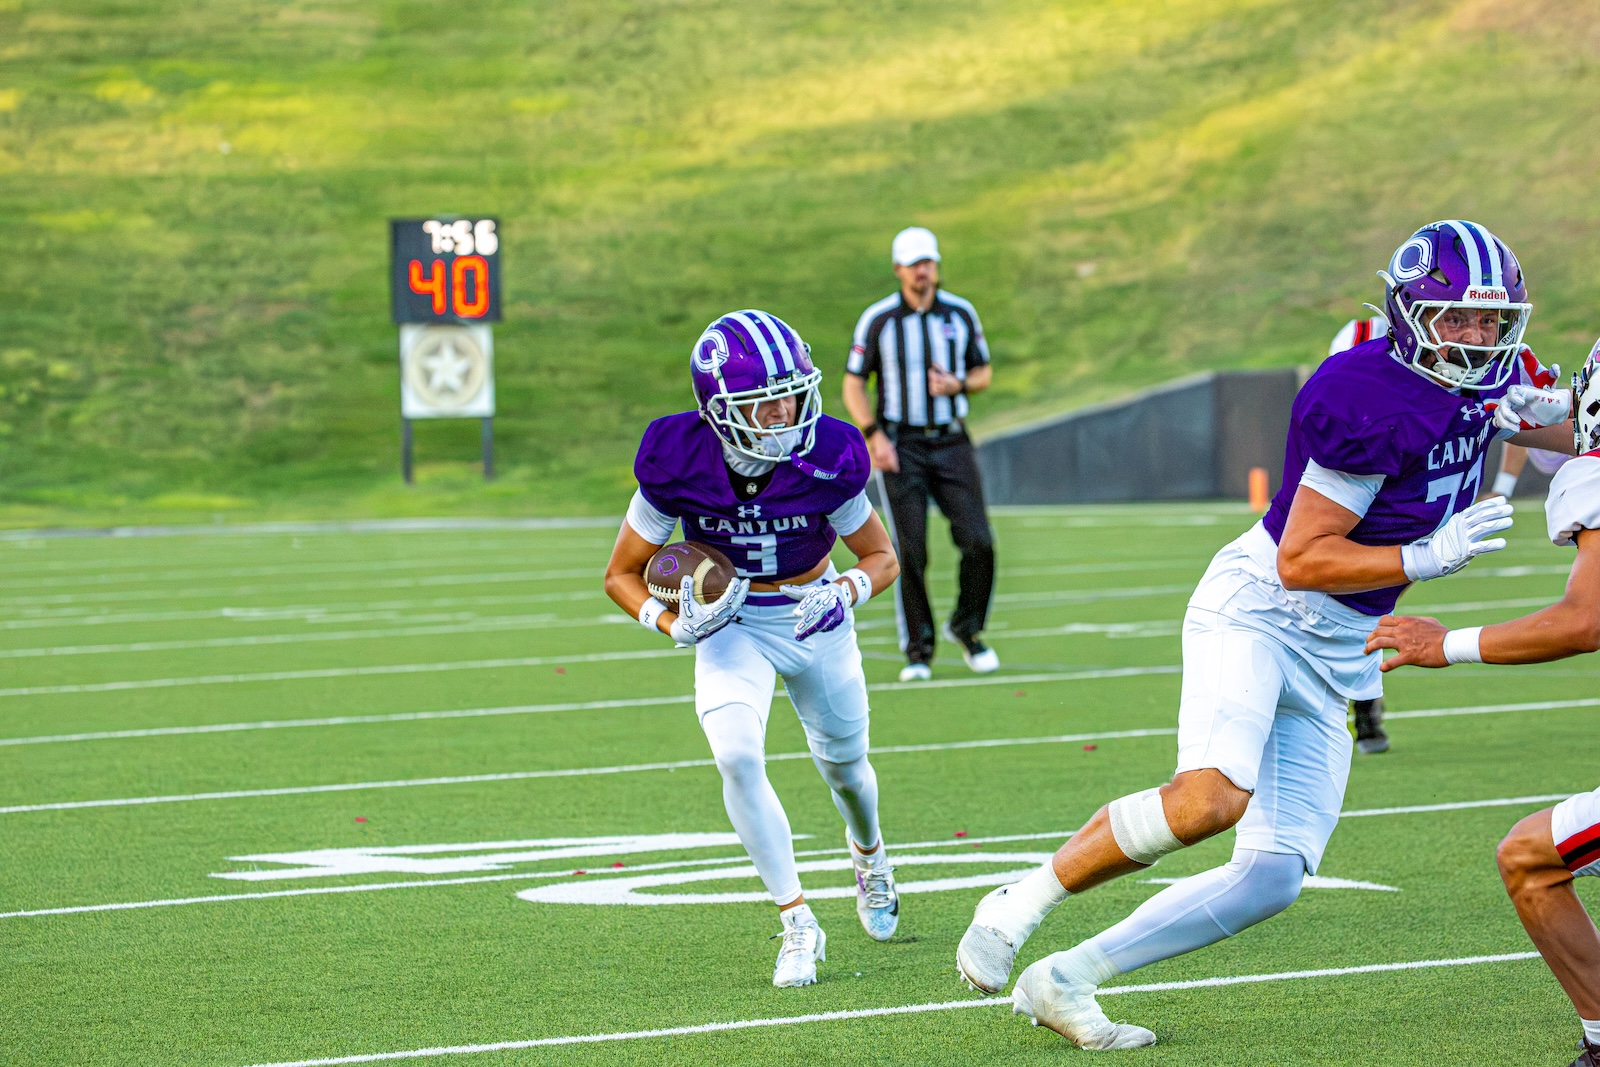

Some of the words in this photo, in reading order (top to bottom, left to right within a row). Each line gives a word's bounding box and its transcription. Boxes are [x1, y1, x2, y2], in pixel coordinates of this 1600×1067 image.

[408, 255, 490, 319] 40
[1469, 290, 1506, 300] Riddell
[698, 515, 808, 534] CANYON
[730, 533, 777, 577] 3
